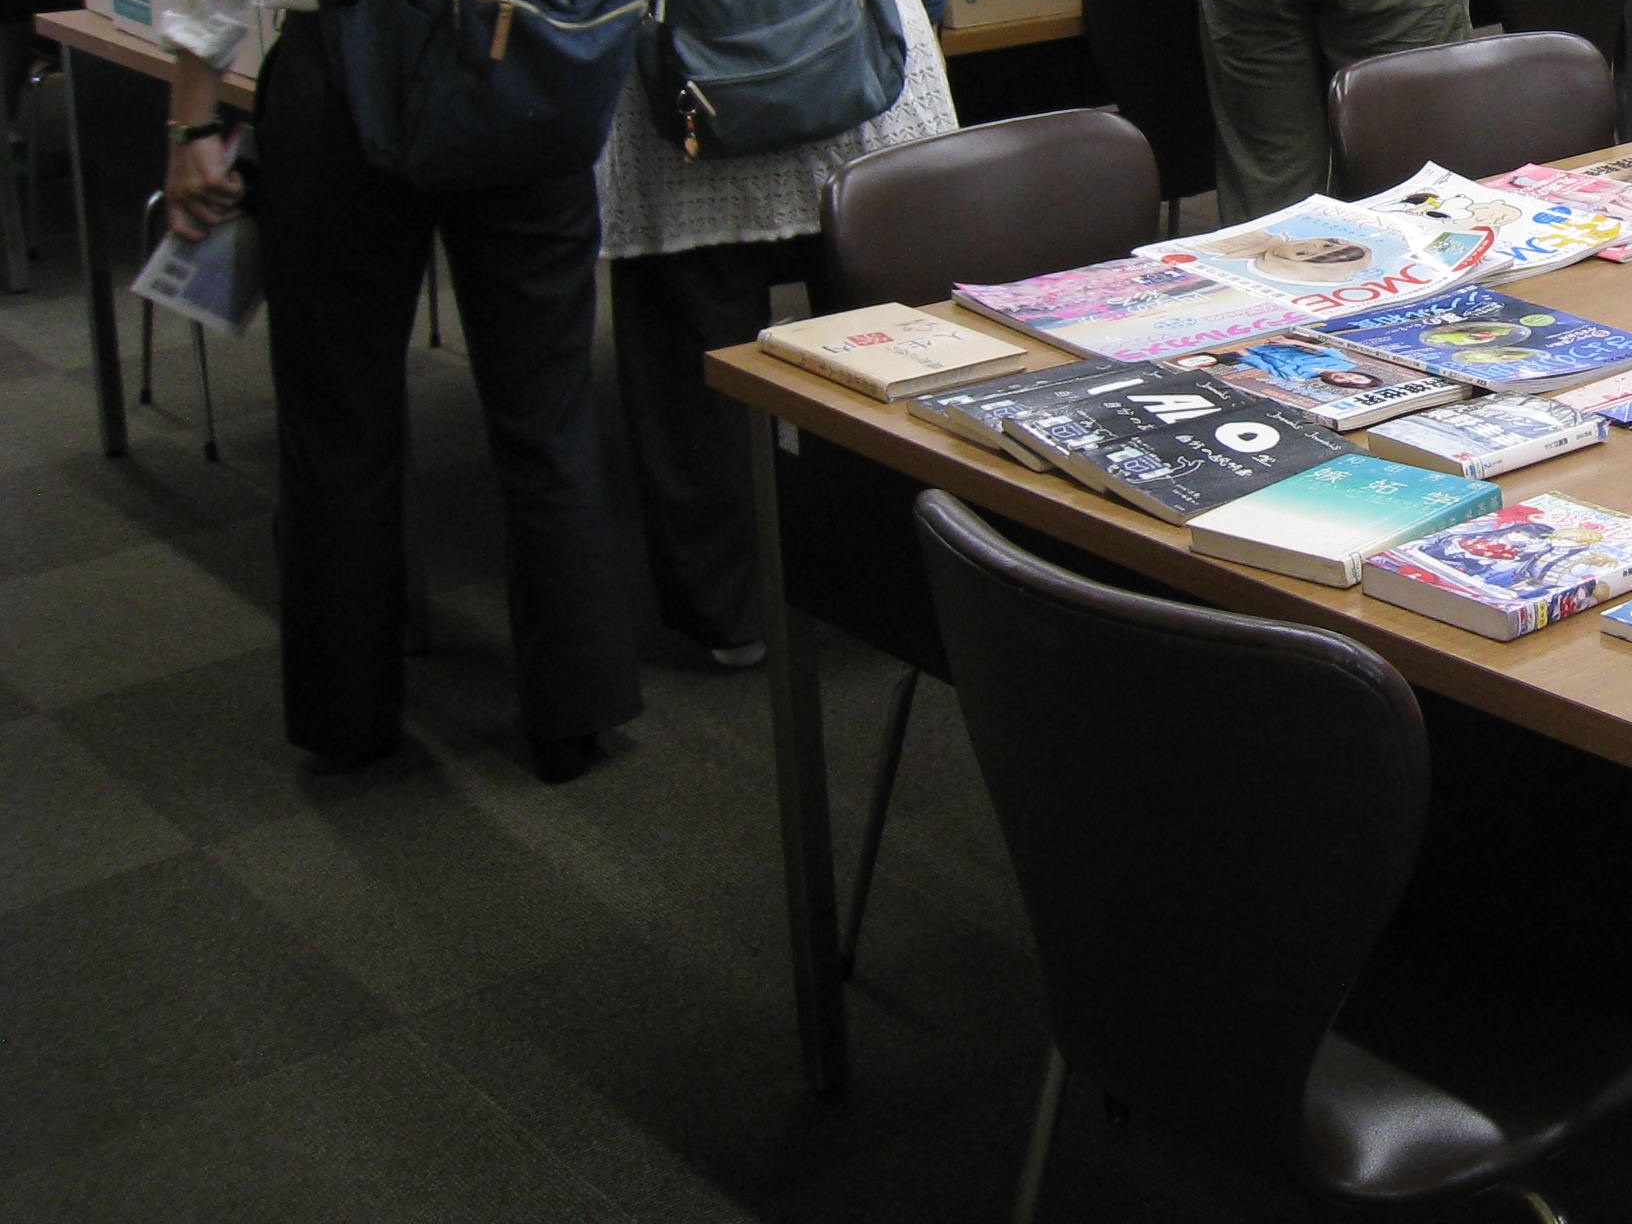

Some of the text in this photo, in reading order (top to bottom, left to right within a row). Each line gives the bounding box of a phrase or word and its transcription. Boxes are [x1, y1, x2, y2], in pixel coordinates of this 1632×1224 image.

[1292, 262, 1435, 313] MOE
[1174, 433, 1257, 477] 自分の説明書
[1306, 467, 1462, 507] 嫉妬学
